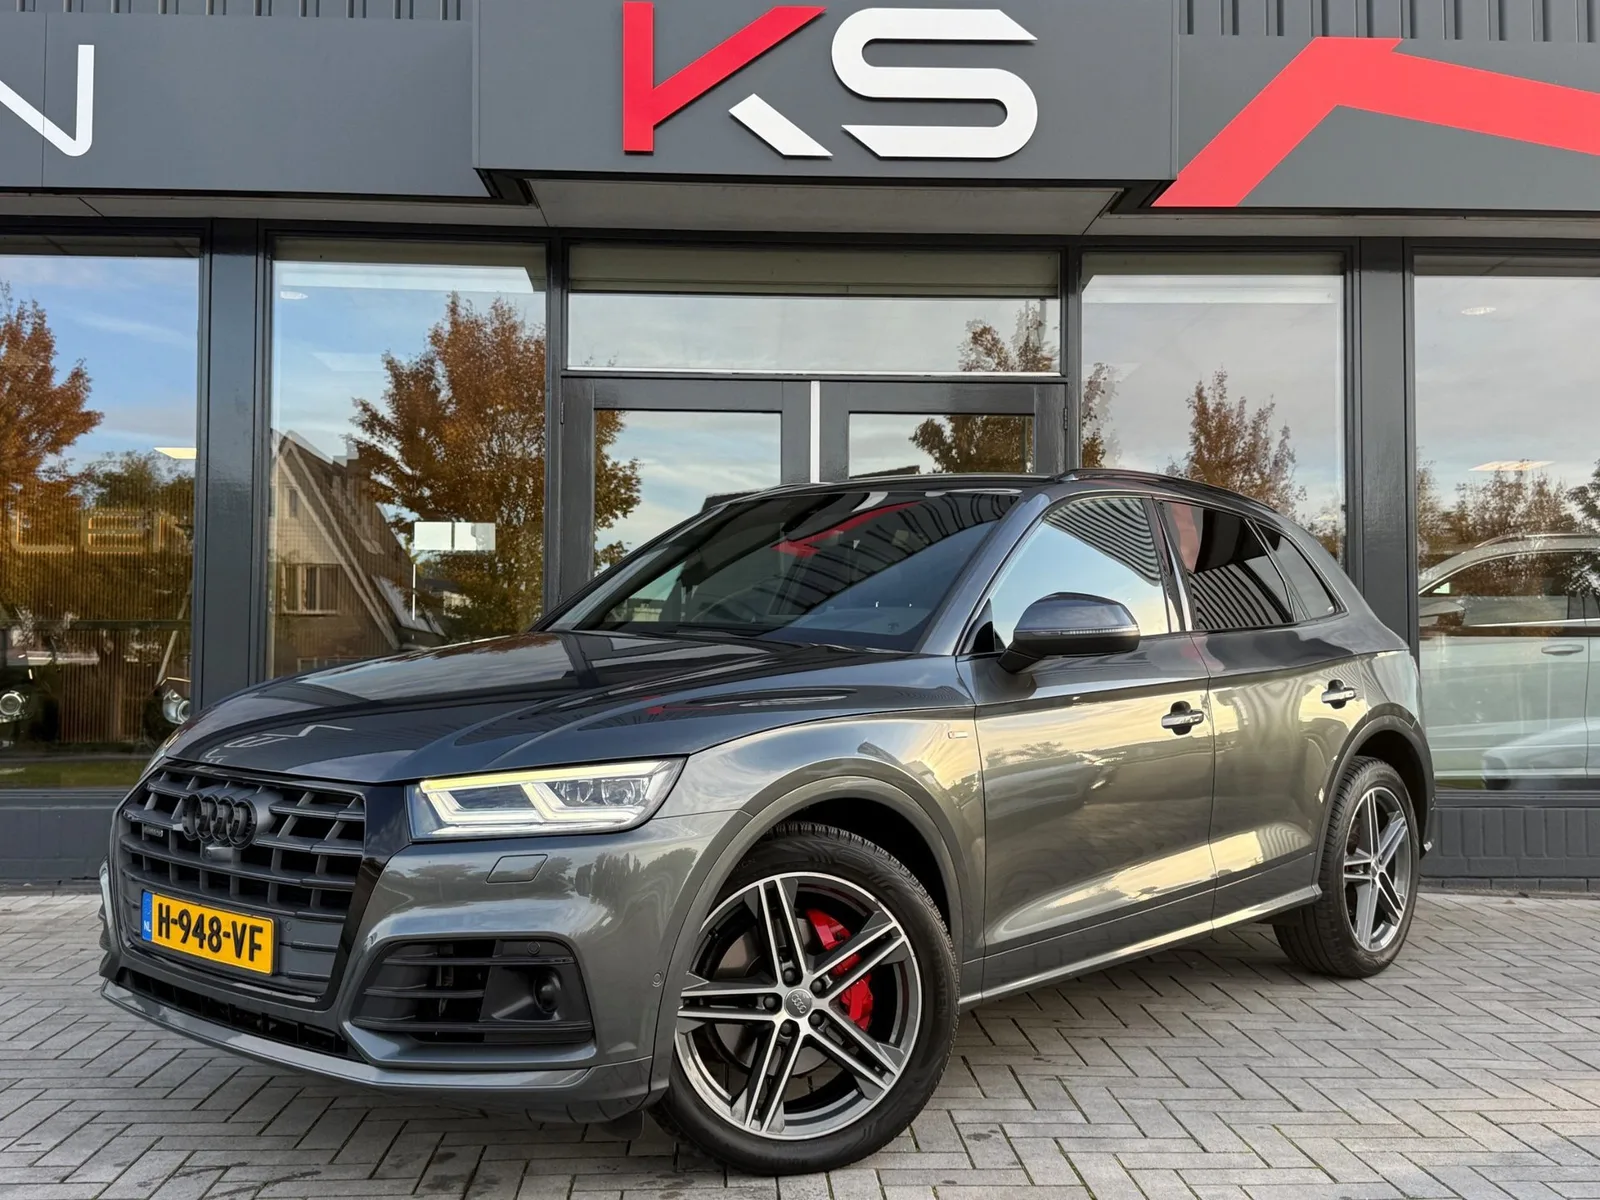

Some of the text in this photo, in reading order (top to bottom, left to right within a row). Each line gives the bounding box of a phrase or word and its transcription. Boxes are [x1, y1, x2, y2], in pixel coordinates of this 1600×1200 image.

[622, 1, 1038, 158] KS
[143, 920, 152, 932] NL
[157, 902, 264, 962] H-948-VF
